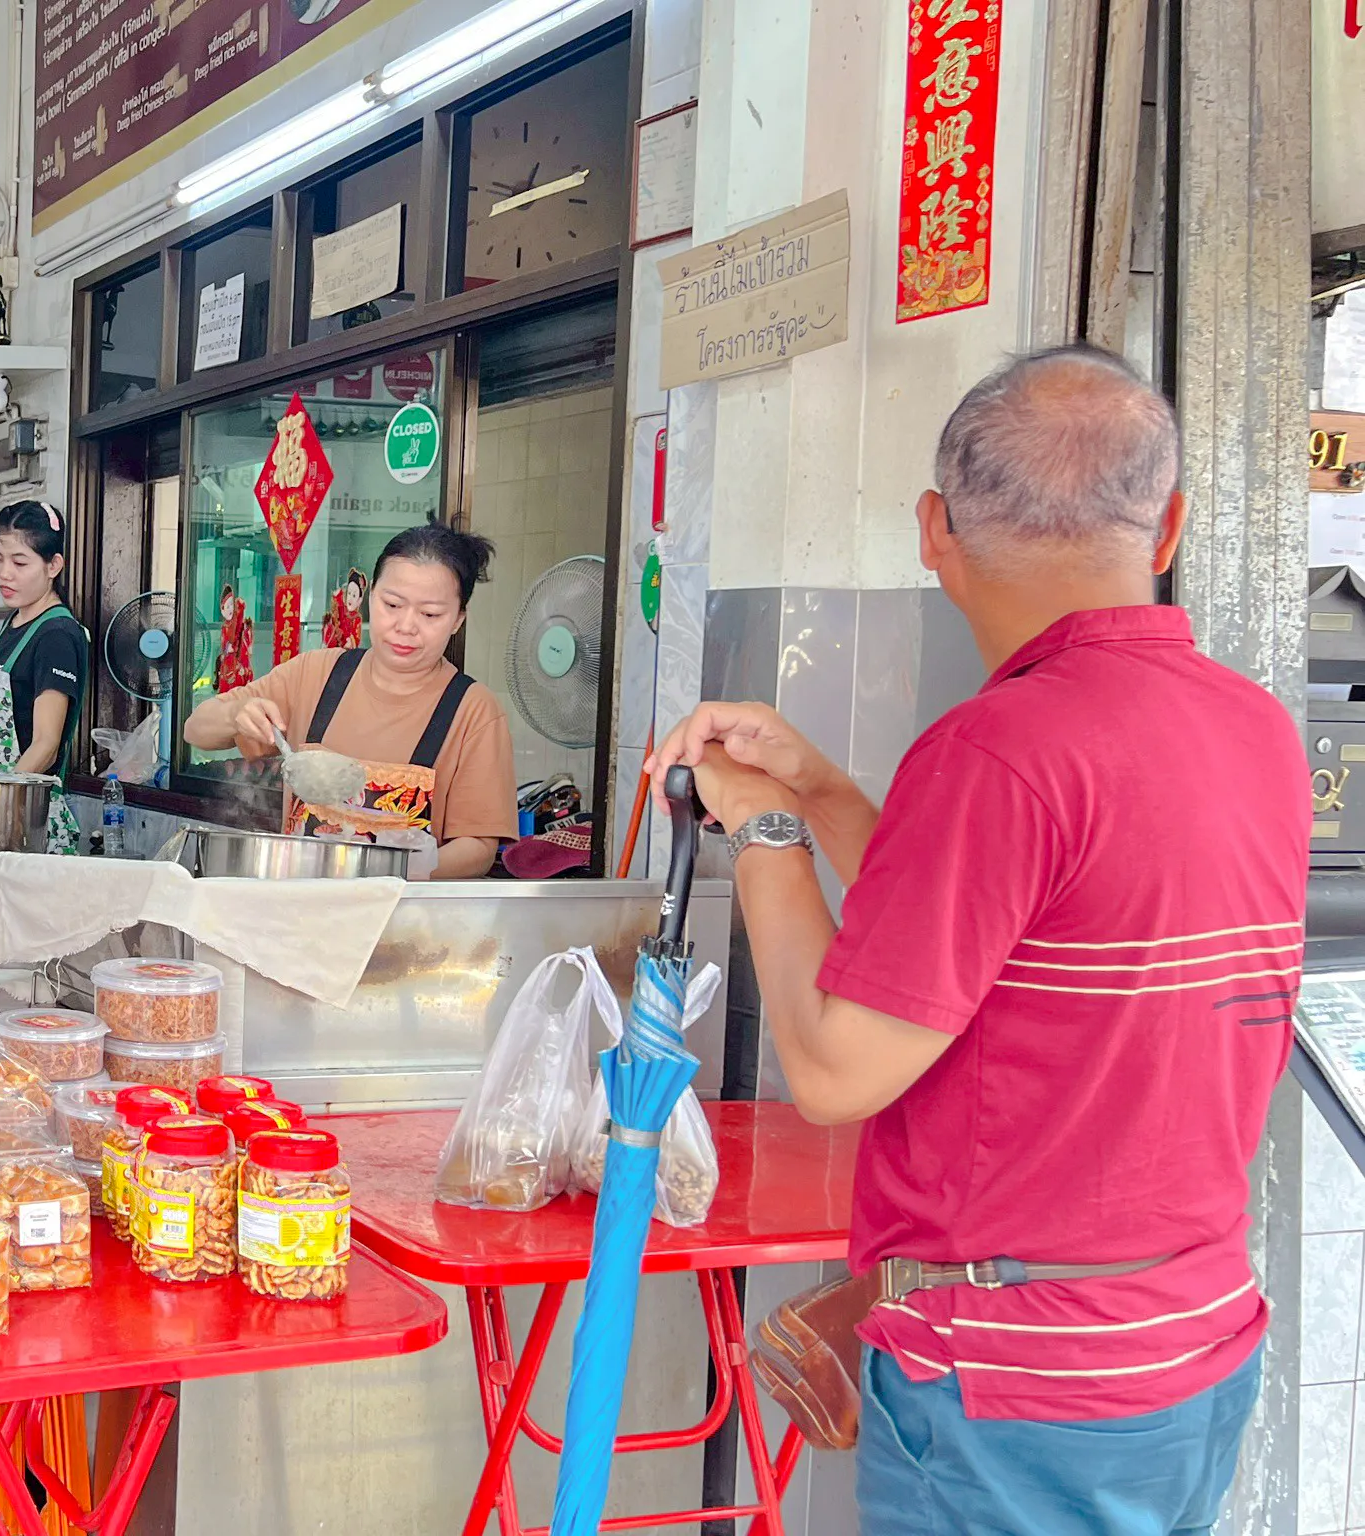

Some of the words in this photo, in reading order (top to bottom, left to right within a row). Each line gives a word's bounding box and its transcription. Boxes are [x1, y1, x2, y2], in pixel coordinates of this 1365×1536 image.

[66, 71, 95, 107] Simmered
[95, 61, 108, 88] pork
[114, 44, 130, 69] offal
[130, 41, 138, 57] in
[195, 64, 209, 82] Deep
[209, 54, 223, 71] fried
[223, 45, 235, 62] rice
[236, 29, 258, 53] noodle
[117, 116, 130, 133] Deep
[131, 107, 144, 124] fried
[144, 96, 164, 116] Chinese
[392, 421, 433, 437] CLOSED
